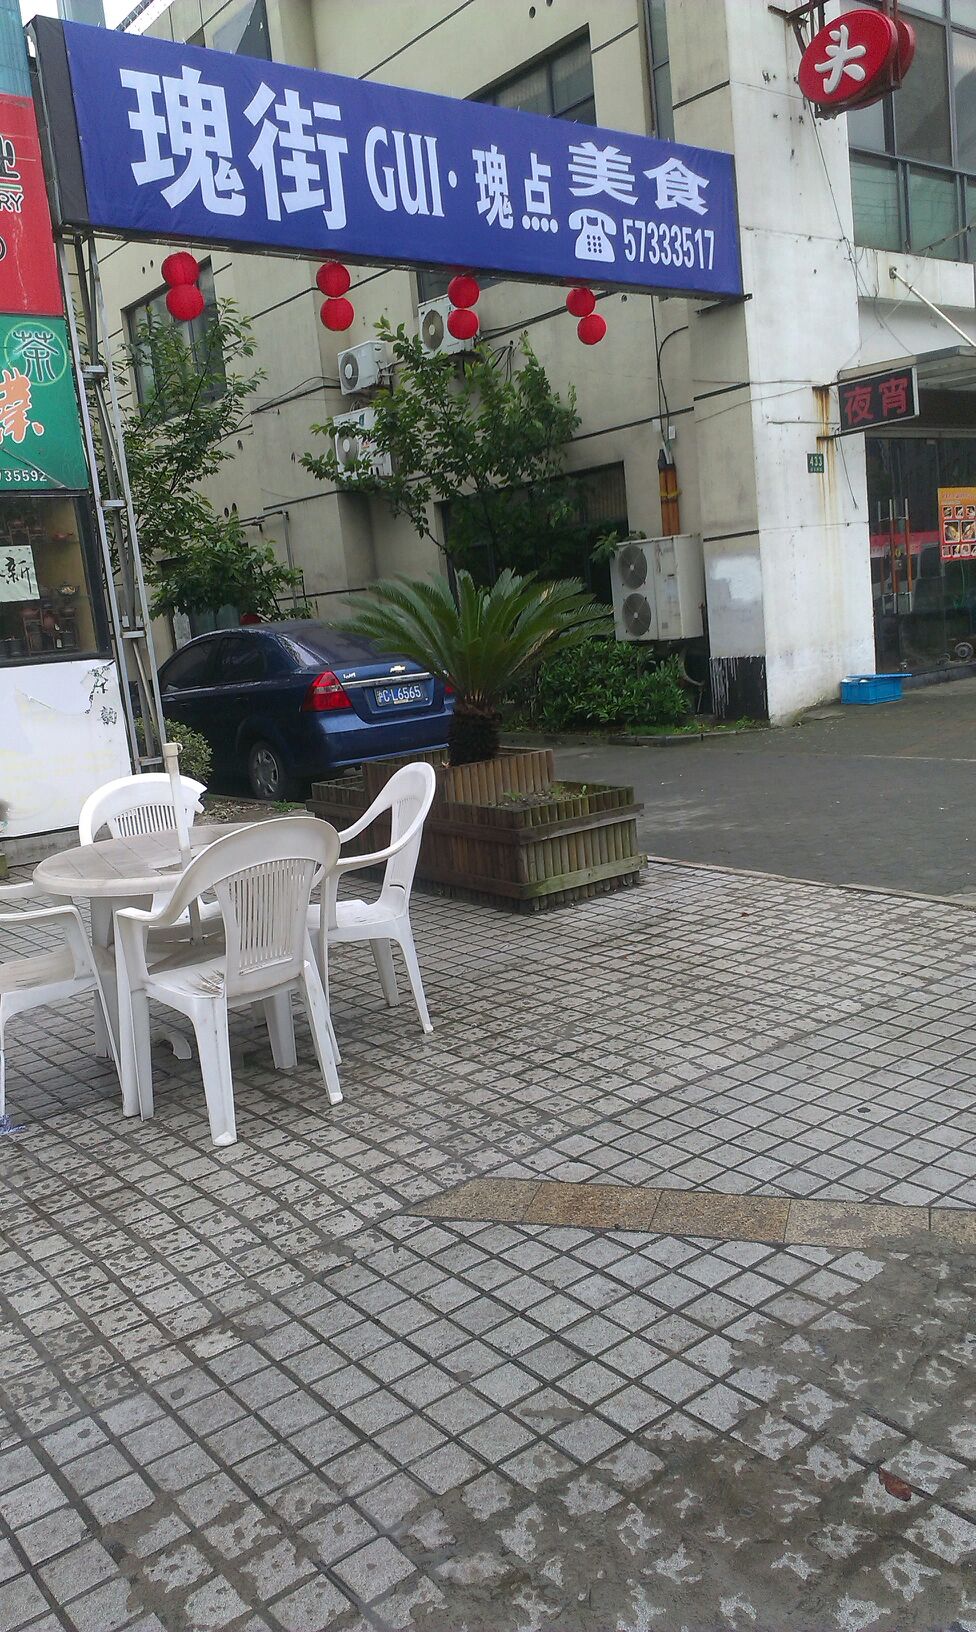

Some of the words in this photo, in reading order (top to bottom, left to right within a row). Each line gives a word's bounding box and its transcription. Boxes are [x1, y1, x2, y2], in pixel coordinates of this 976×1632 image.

[815, 24, 867, 94] 头
[119, 65, 348, 230] 瑰街
[472, 144, 559, 233] 瑰点
[568, 141, 711, 216] 美食
[622, 218, 715, 270] 57333517
[844, 377, 908, 425] 夜宵
[0, 469, 47, 482] 35592
